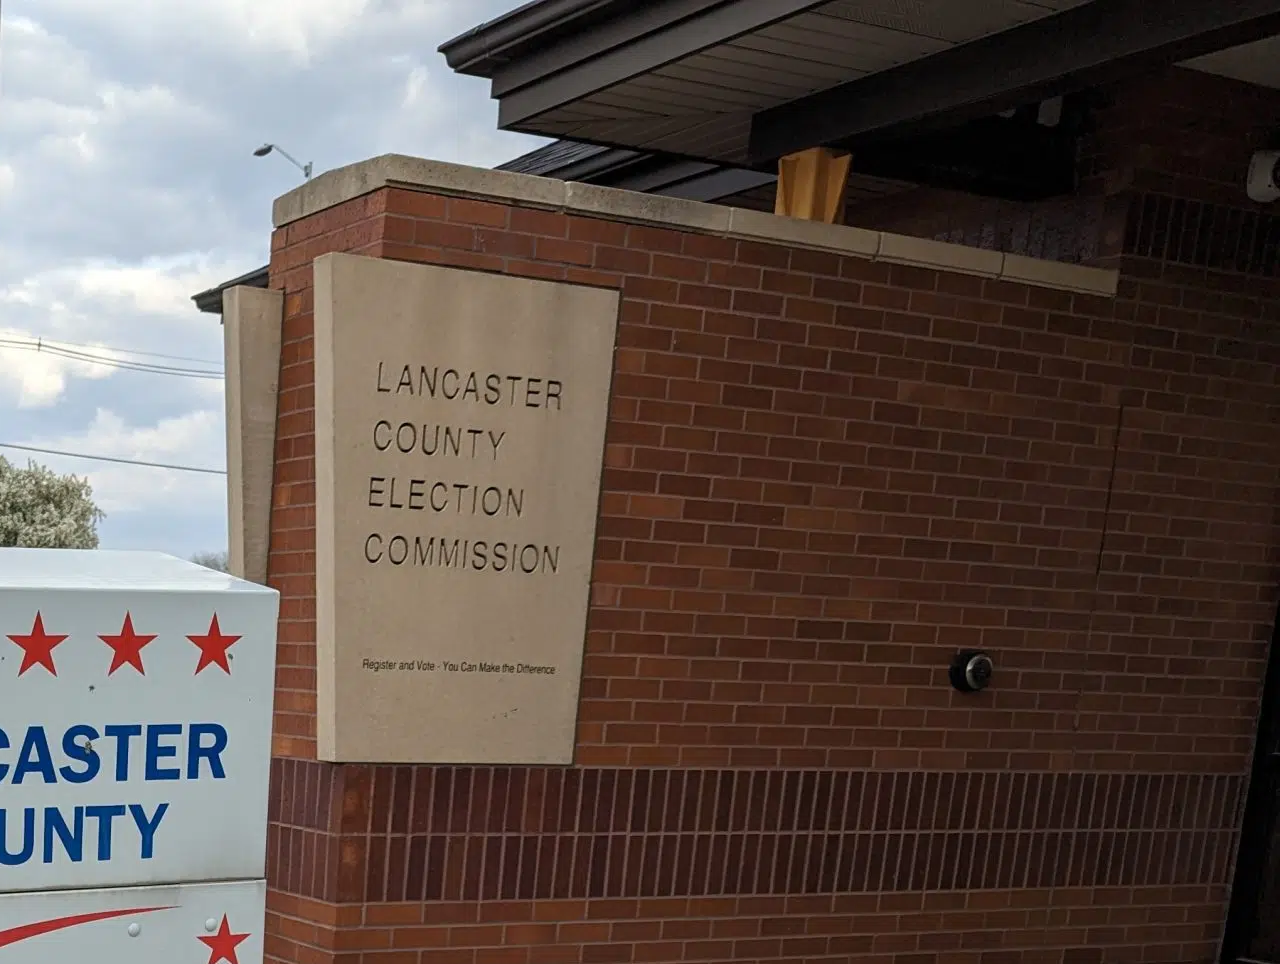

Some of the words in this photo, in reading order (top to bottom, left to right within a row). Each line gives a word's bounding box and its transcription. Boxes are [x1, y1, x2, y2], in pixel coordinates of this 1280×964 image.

[376, 361, 563, 410] LANCASTER
[373, 420, 506, 460] COUNTY
[368, 477, 524, 517] ELECTION
[364, 533, 561, 574] COMMISSION
[362, 658, 397, 672] Register
[399, 660, 415, 671] and
[417, 660, 435, 671] Vote
[442, 661, 459, 672] You
[460, 661, 477, 673] Can
[479, 663, 501, 673] Make
[502, 663, 514, 674] the
[516, 663, 556, 675] Difference
